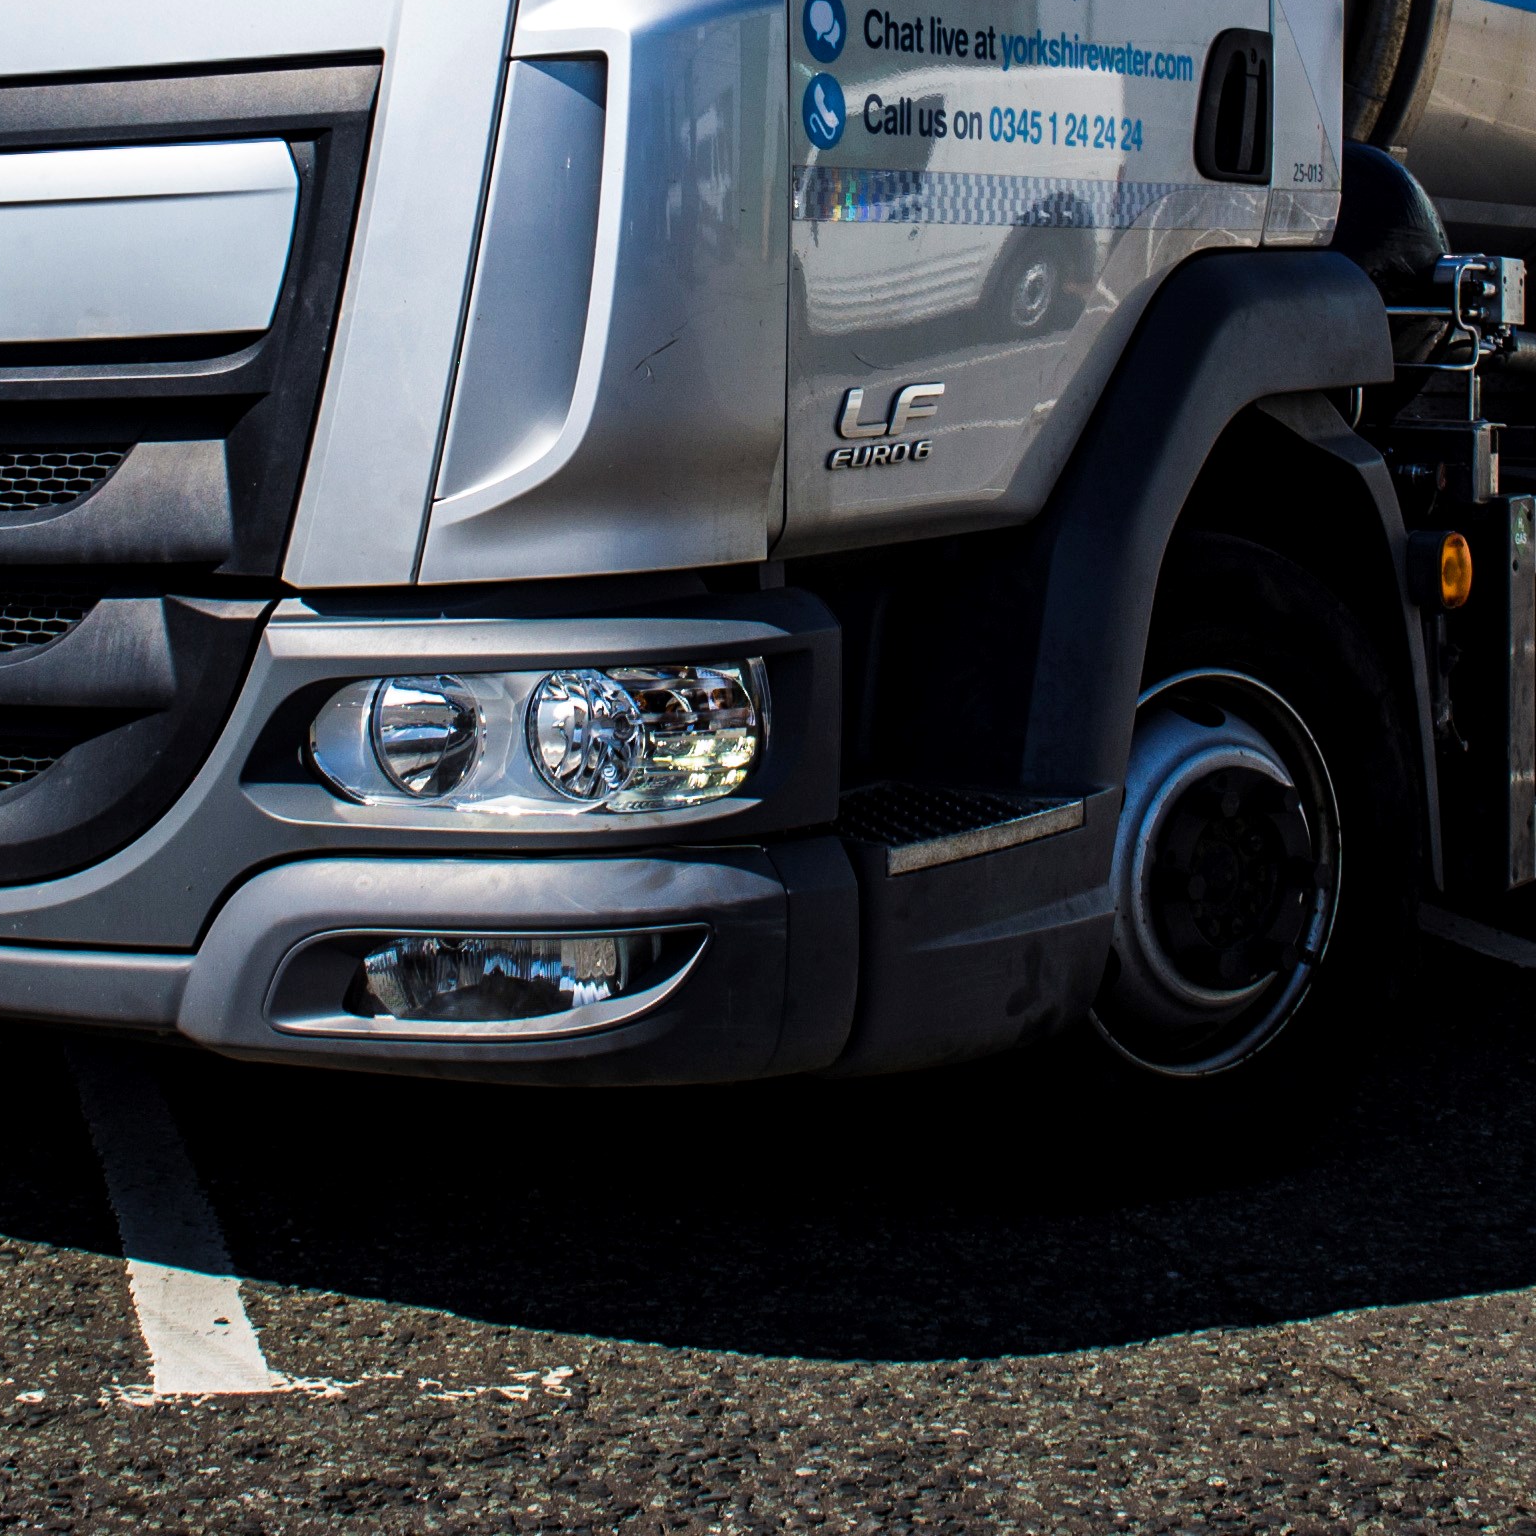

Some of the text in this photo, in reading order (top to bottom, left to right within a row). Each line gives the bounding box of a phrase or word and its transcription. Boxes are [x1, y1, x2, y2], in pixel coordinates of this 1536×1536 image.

[864, 9, 1193, 82] Chat live at yorkshirewater.com
[864, 93, 1143, 152] Call us on 0345 1 24 24 24
[1293, 162, 1324, 183] 25-013
[835, 382, 946, 439] LF
[826, 443, 910, 471] EURO
[1514, 532, 1528, 545] GAS
